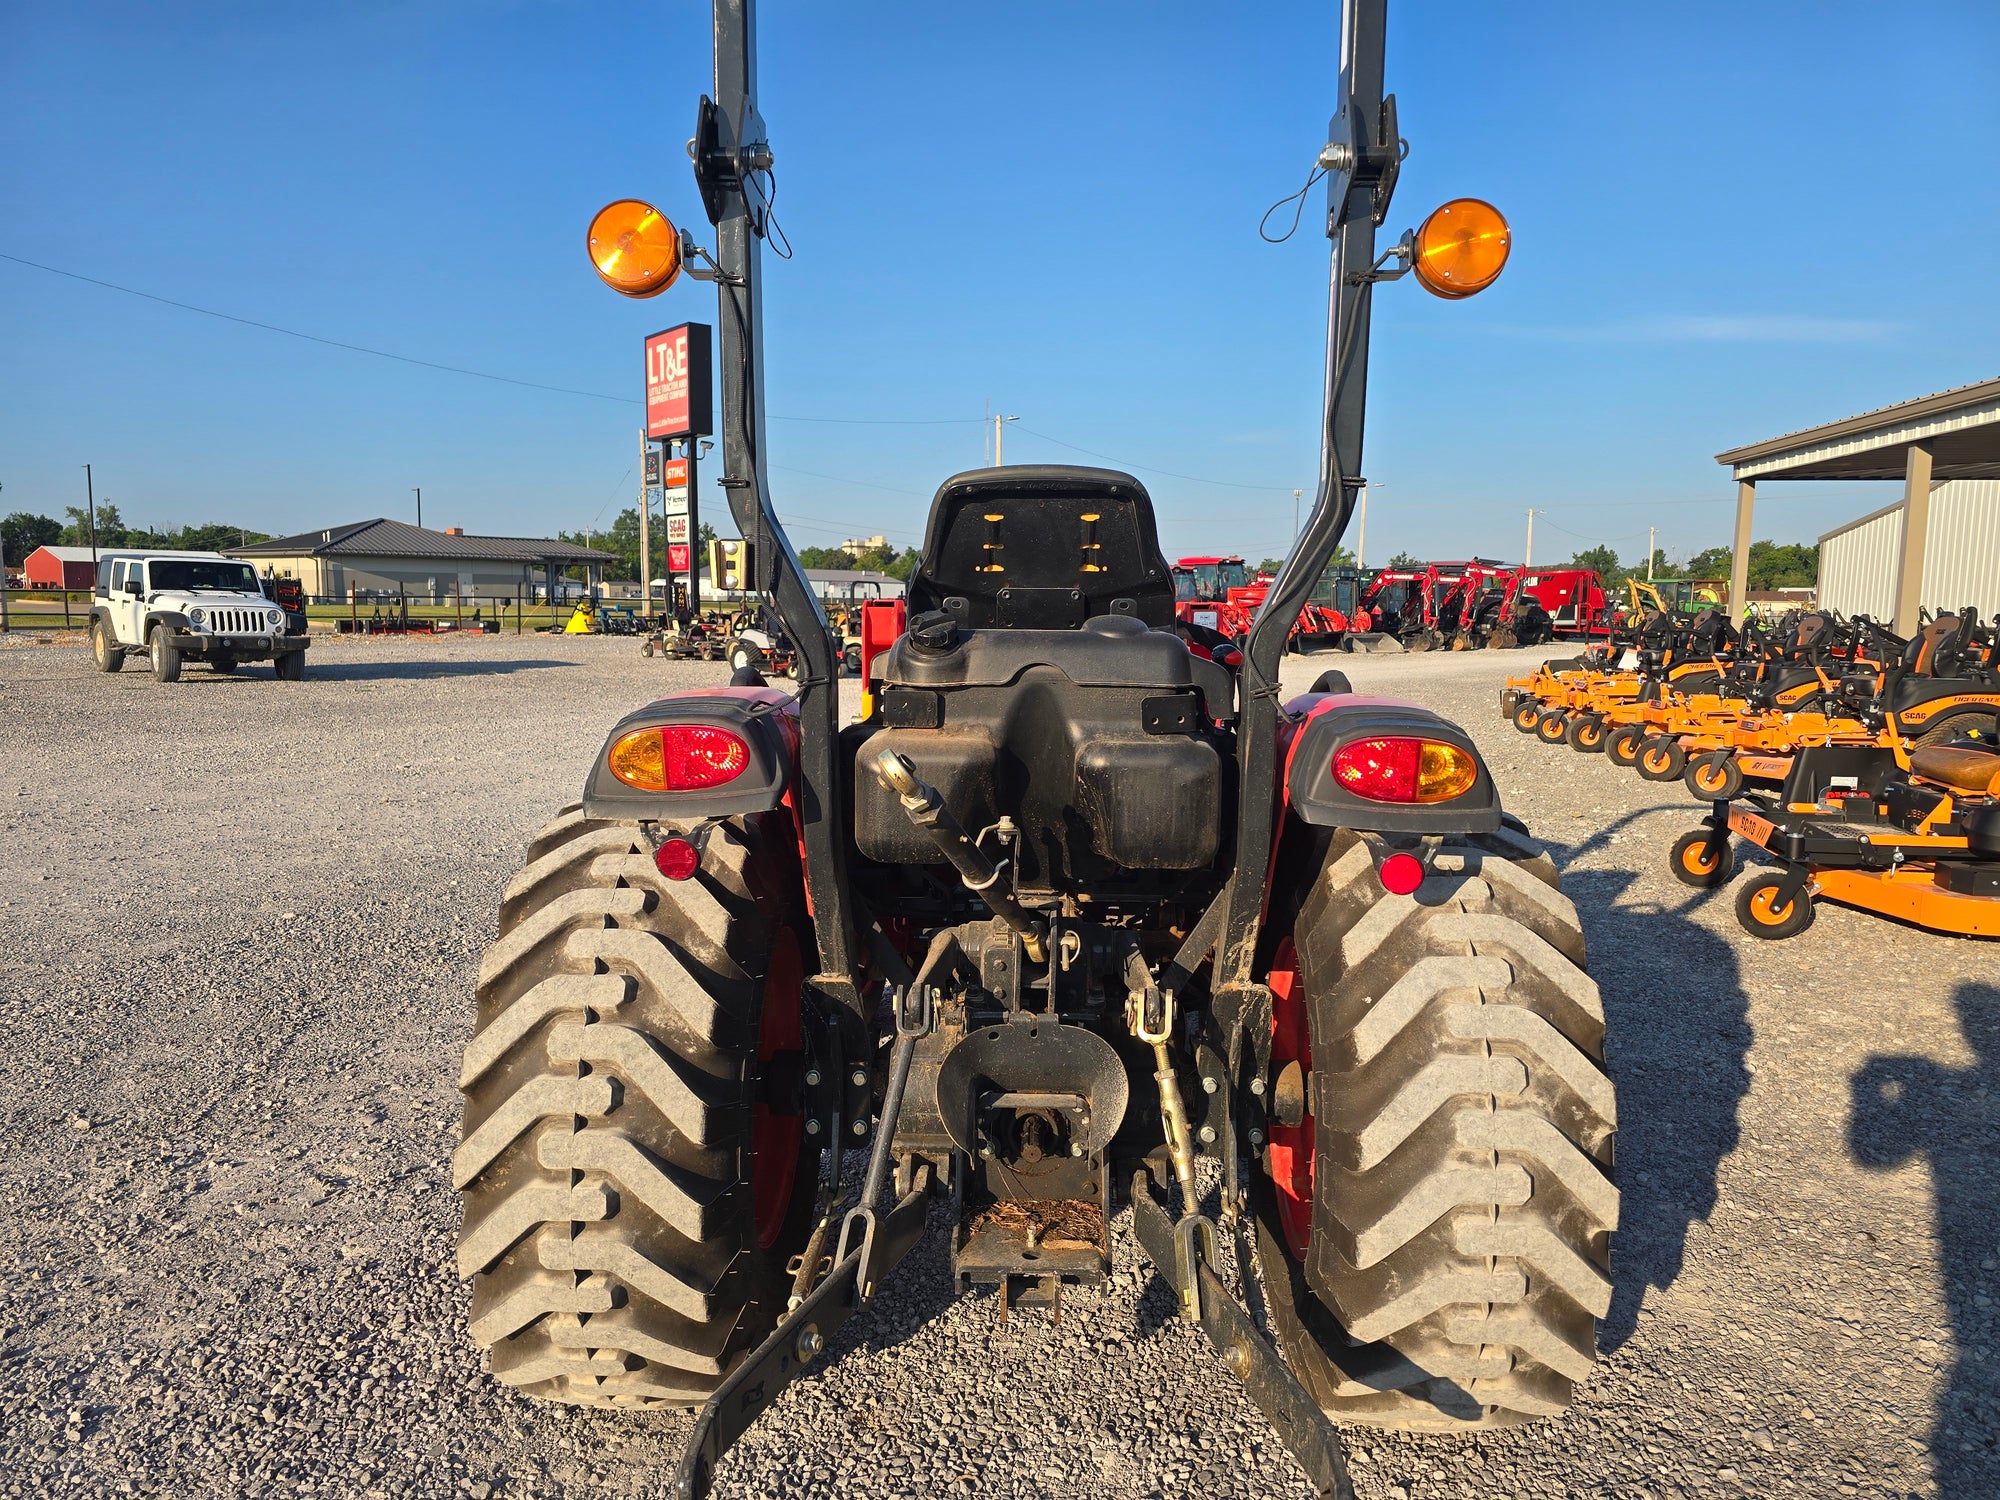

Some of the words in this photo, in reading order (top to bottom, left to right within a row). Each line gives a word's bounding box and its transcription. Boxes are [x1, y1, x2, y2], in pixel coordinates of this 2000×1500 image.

[648, 336, 687, 385] LT&E
[667, 467, 686, 479] STIHL
[669, 518, 686, 533] SCAG
[1904, 711, 1927, 720] SCAG
[1741, 815, 1757, 836] SCAG
